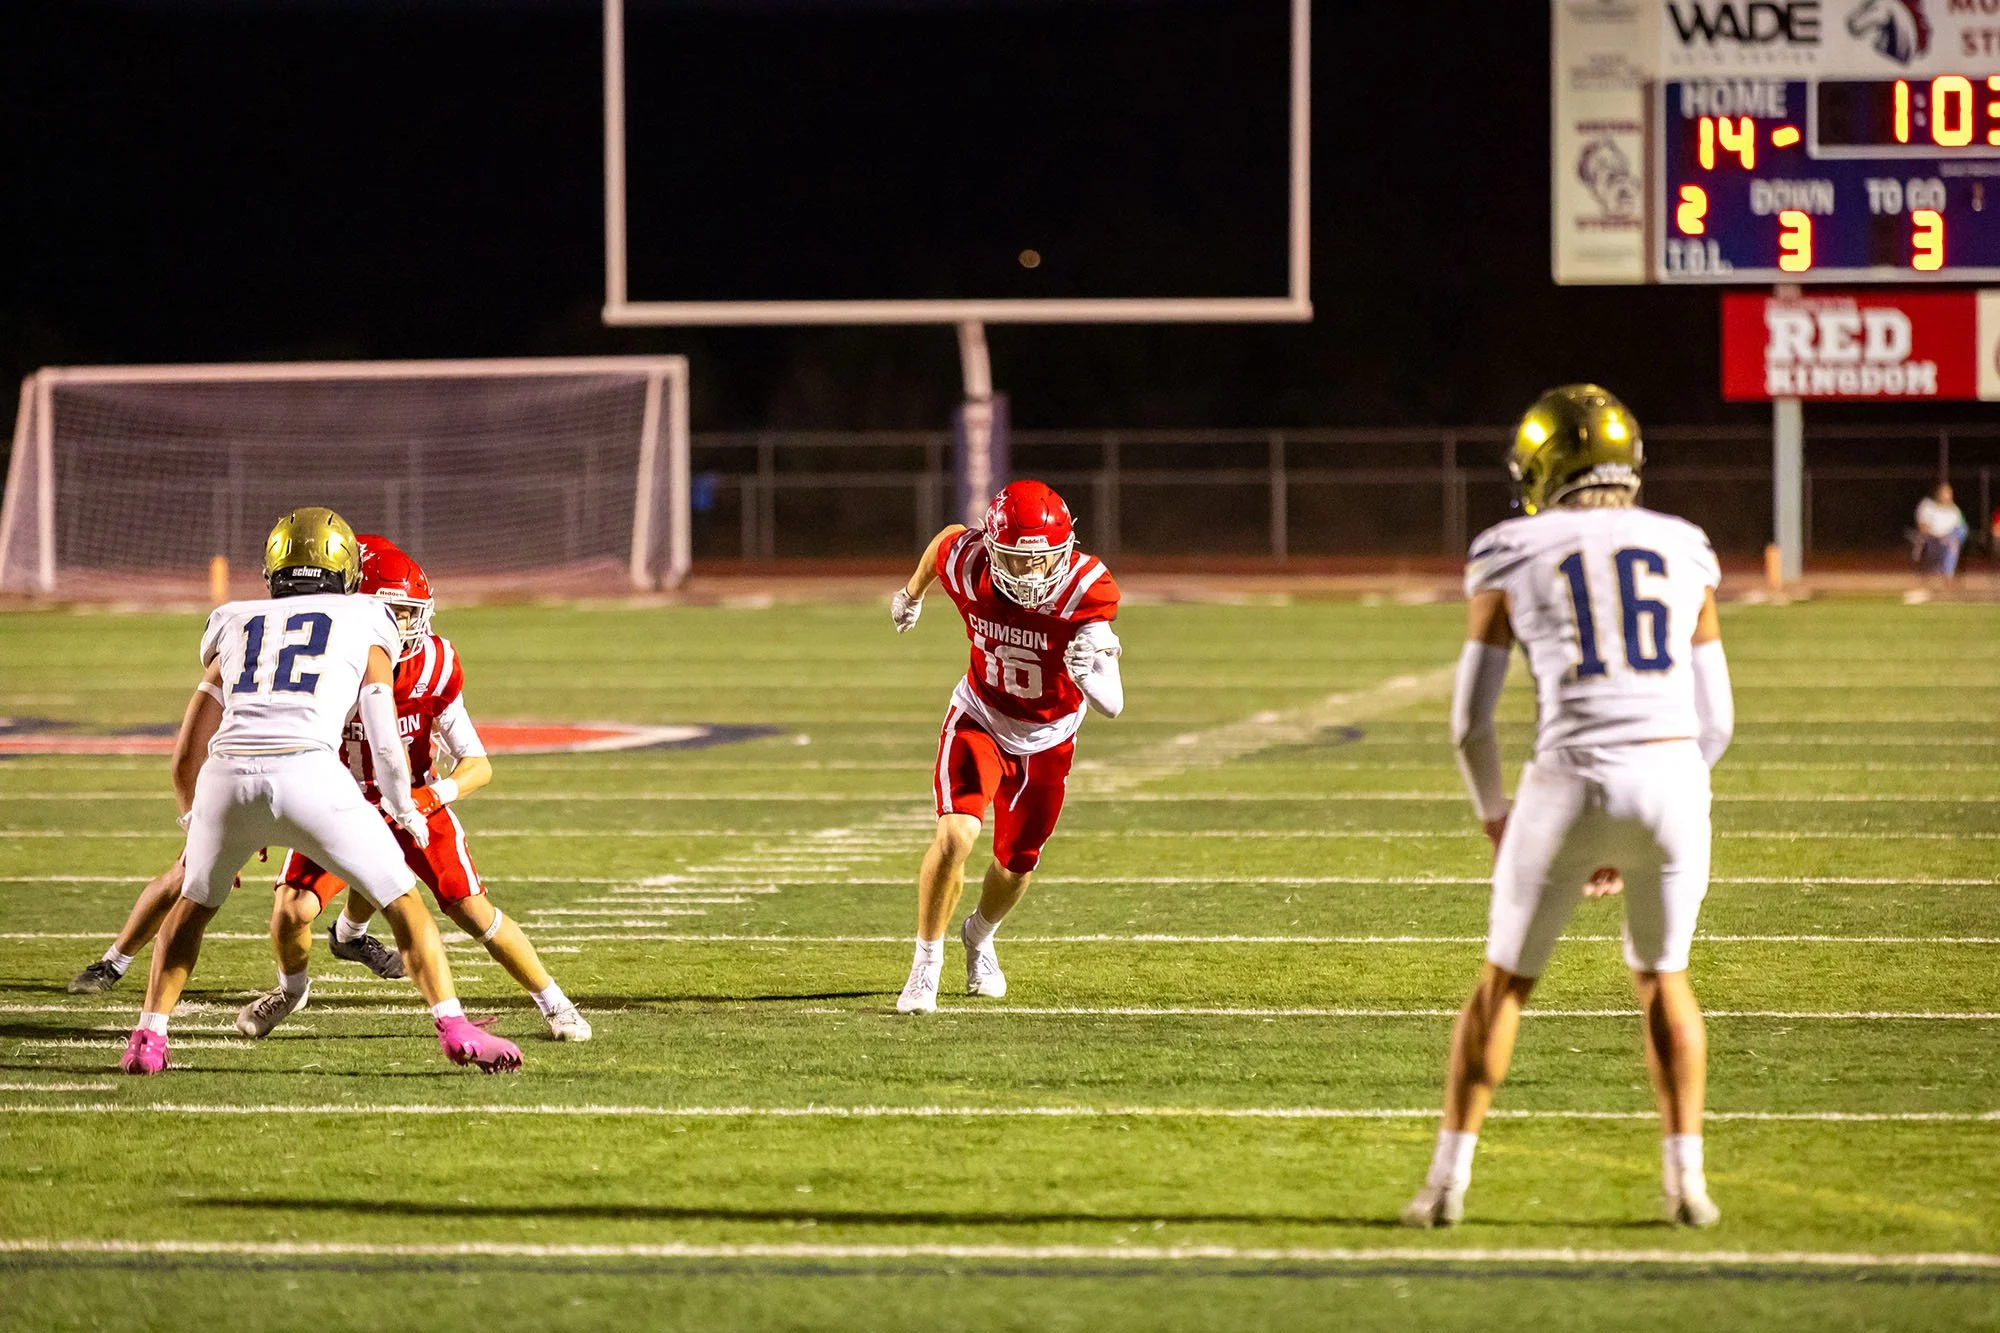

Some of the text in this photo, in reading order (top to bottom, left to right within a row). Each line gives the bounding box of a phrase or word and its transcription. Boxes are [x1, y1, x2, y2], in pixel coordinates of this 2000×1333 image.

[1668, 2, 1821, 44] WADE
[1961, 28, 2000, 56] ST
[1681, 82, 1788, 118] HOME
[1676, 184, 1708, 235] 2
[1749, 179, 1834, 215] DOWN
[1867, 179, 1947, 215] TO GO
[1778, 210, 1812, 272] 3
[1911, 209, 1945, 271] 3
[1766, 308, 1912, 361] RED
[1766, 360, 1938, 395] KINGDOM
[292, 566, 322, 577] schutt
[967, 613, 1049, 651] CRIMSON
[1558, 546, 1674, 678] 16
[231, 611, 333, 695] 12
[973, 631, 1043, 699] 16
